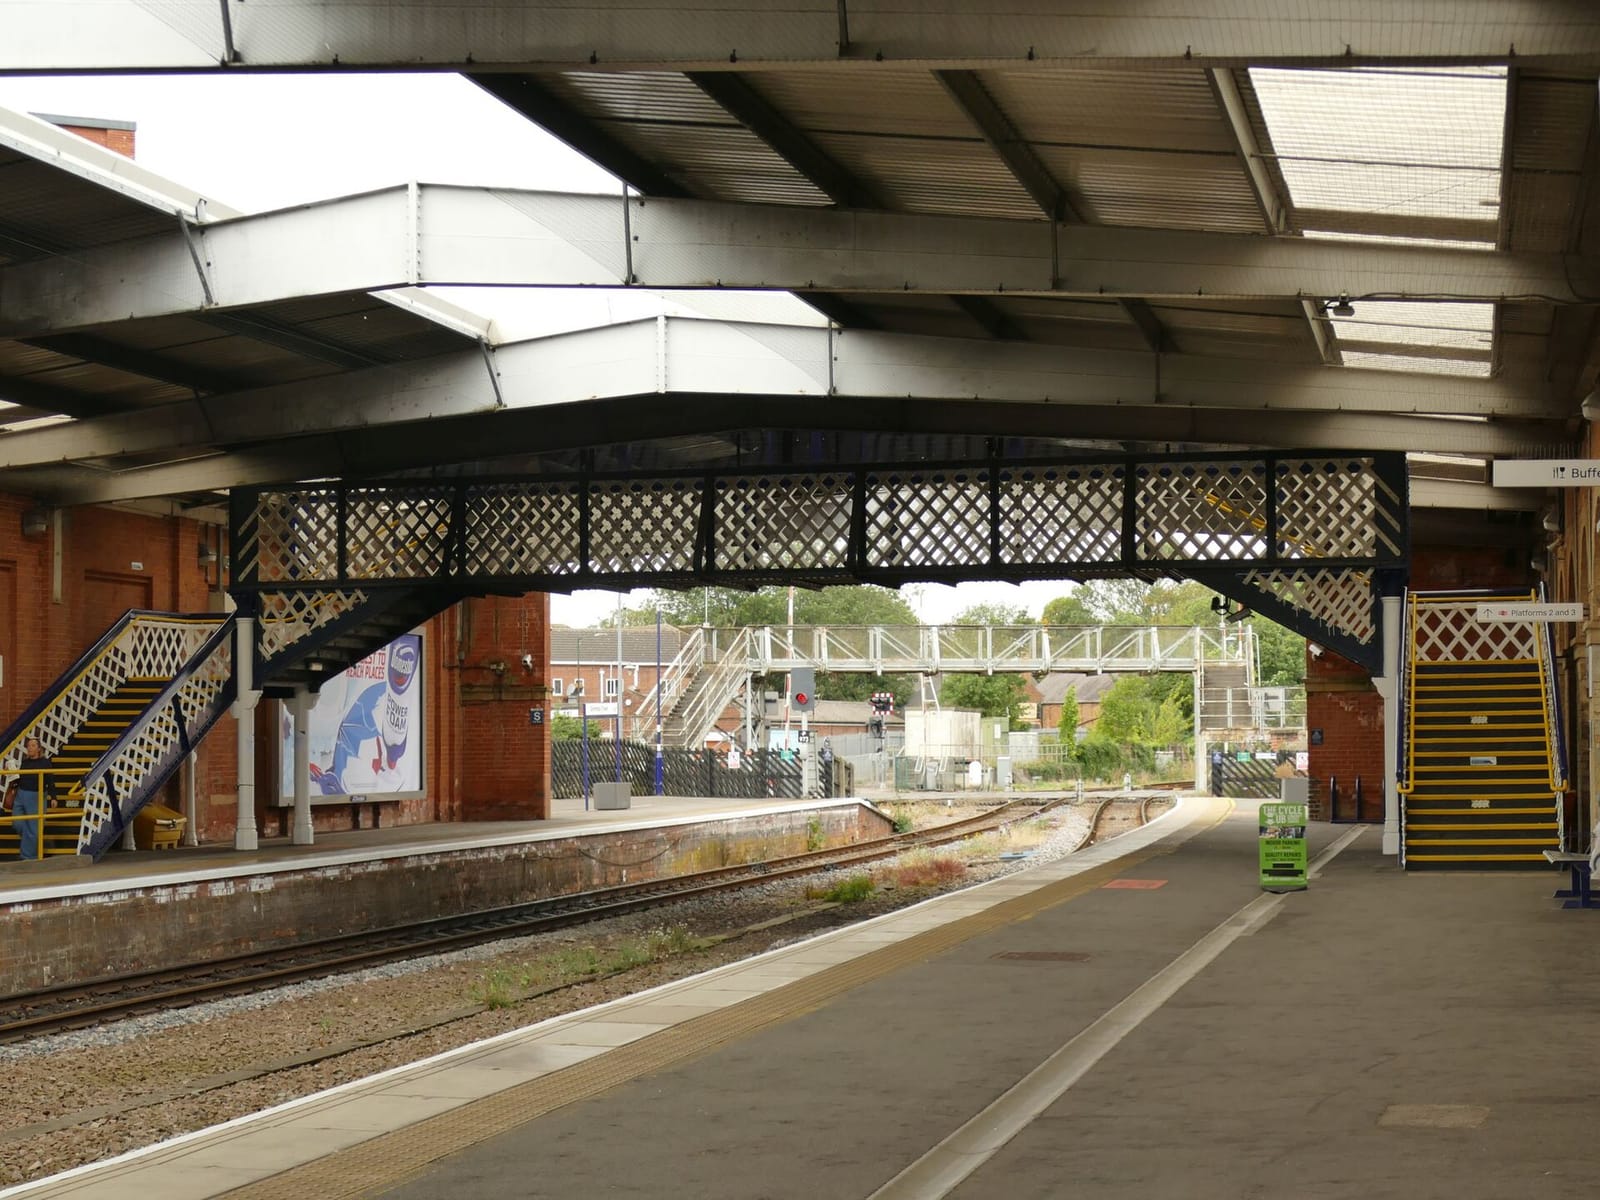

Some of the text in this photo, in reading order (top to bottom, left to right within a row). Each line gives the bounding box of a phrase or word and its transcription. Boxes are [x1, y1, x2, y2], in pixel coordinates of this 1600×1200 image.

[1511, 609, 1547, 617] Platforms
[1548, 609, 1554, 617] 2
[1555, 609, 1570, 617] and
[378, 652, 386, 666] TO
[364, 665, 385, 680] PLACES
[387, 693, 408, 717] POWER
[386, 703, 407, 730] FOAM
[534, 711, 541, 721] S
[1278, 805, 1303, 815] CYCLE
